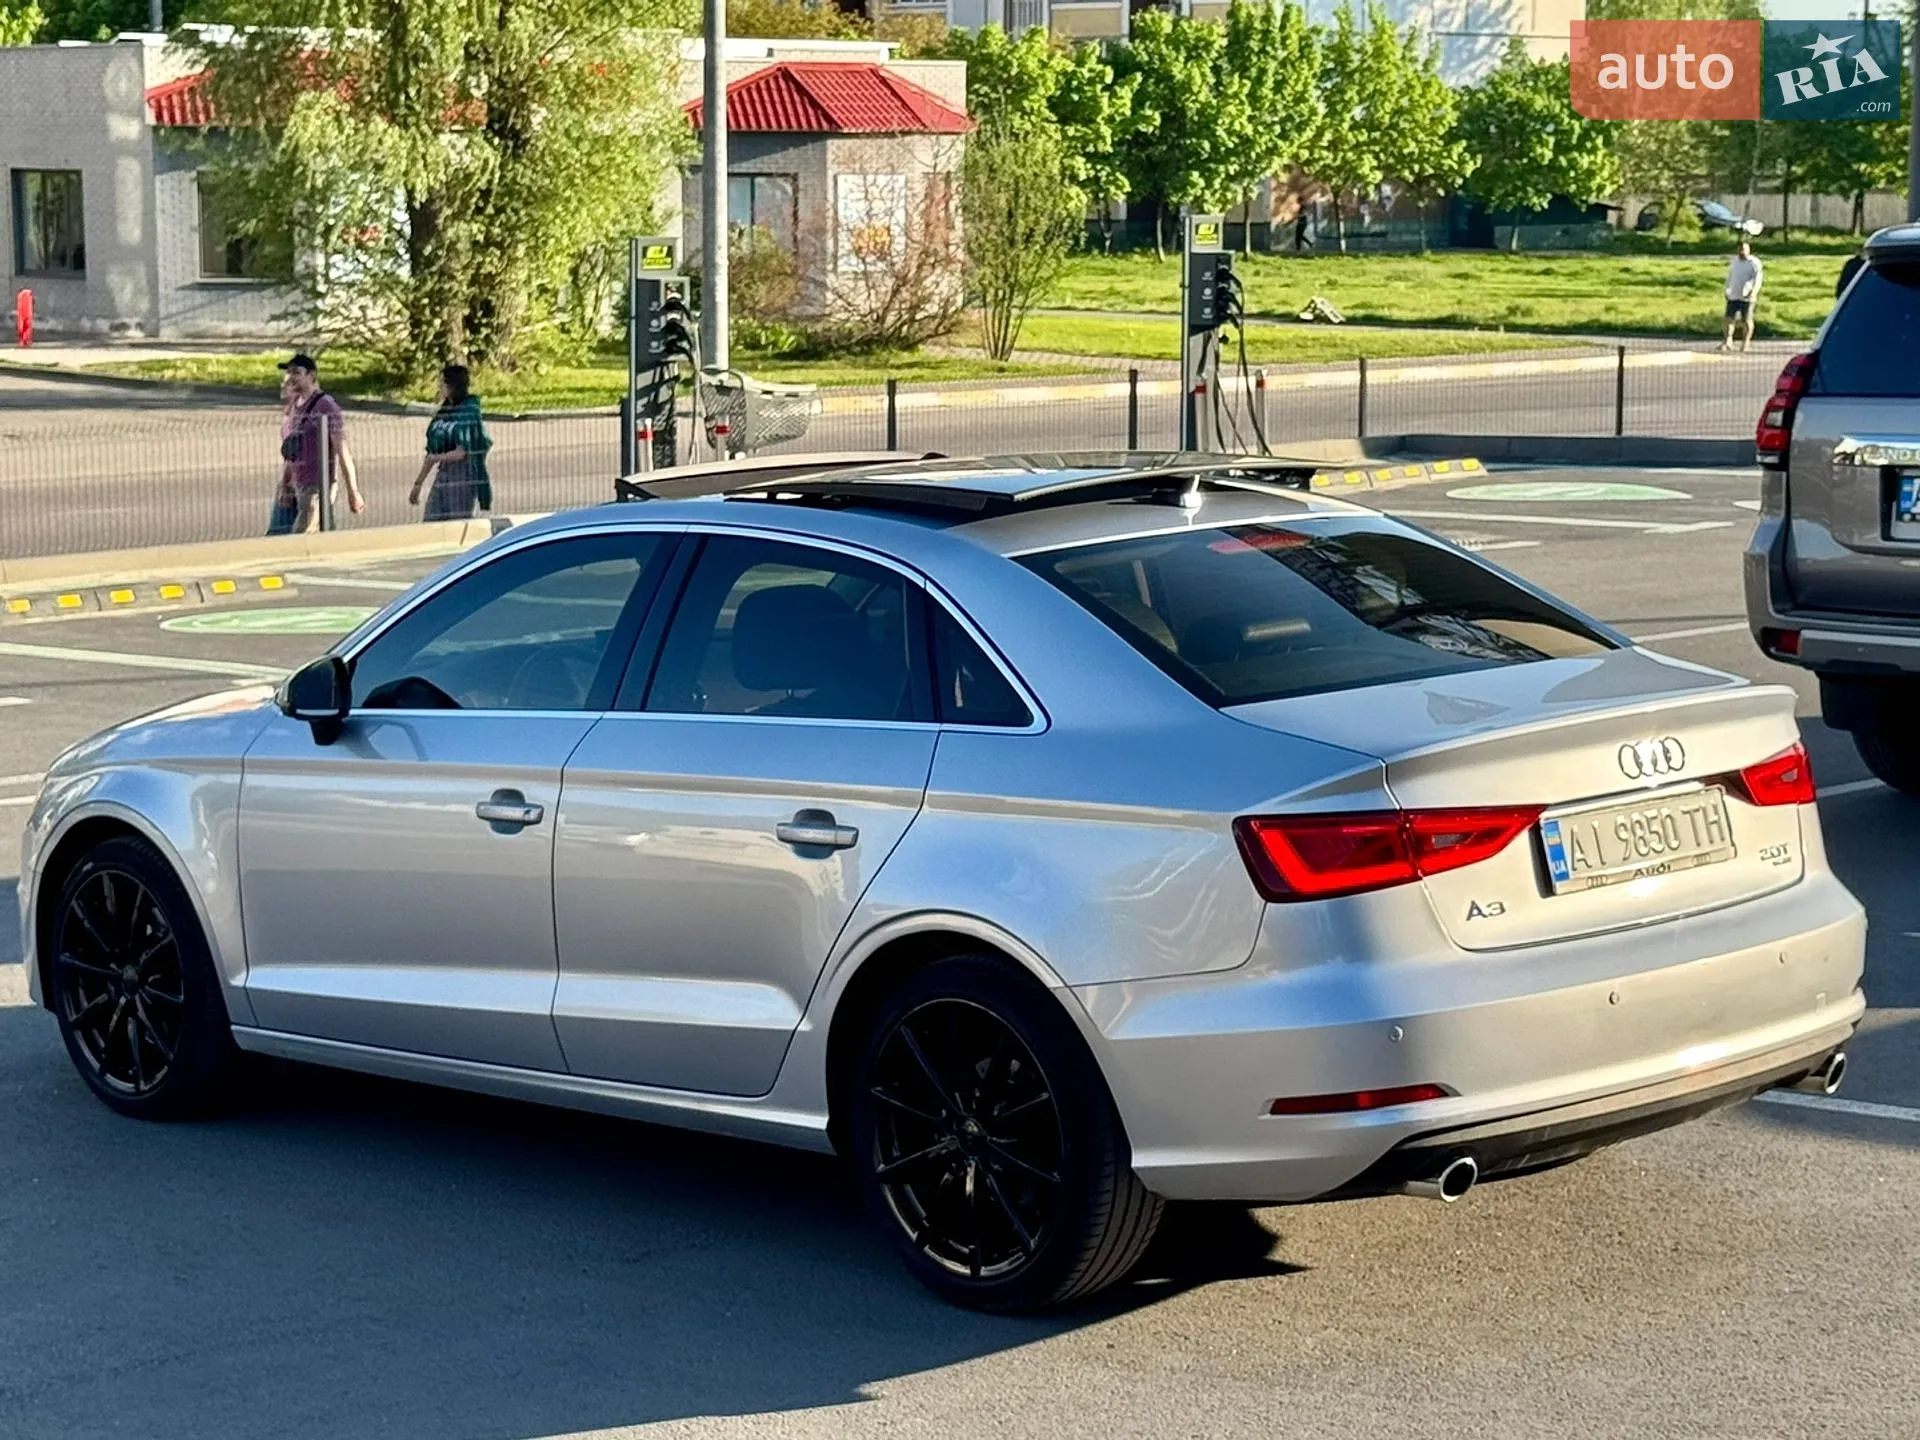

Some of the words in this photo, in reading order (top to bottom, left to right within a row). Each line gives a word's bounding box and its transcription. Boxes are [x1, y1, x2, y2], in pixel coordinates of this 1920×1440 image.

[1569, 819, 1607, 872] AI
[1613, 806, 1681, 862] 9850
[1680, 801, 1725, 848] TH
[1466, 899, 1507, 921] A3
